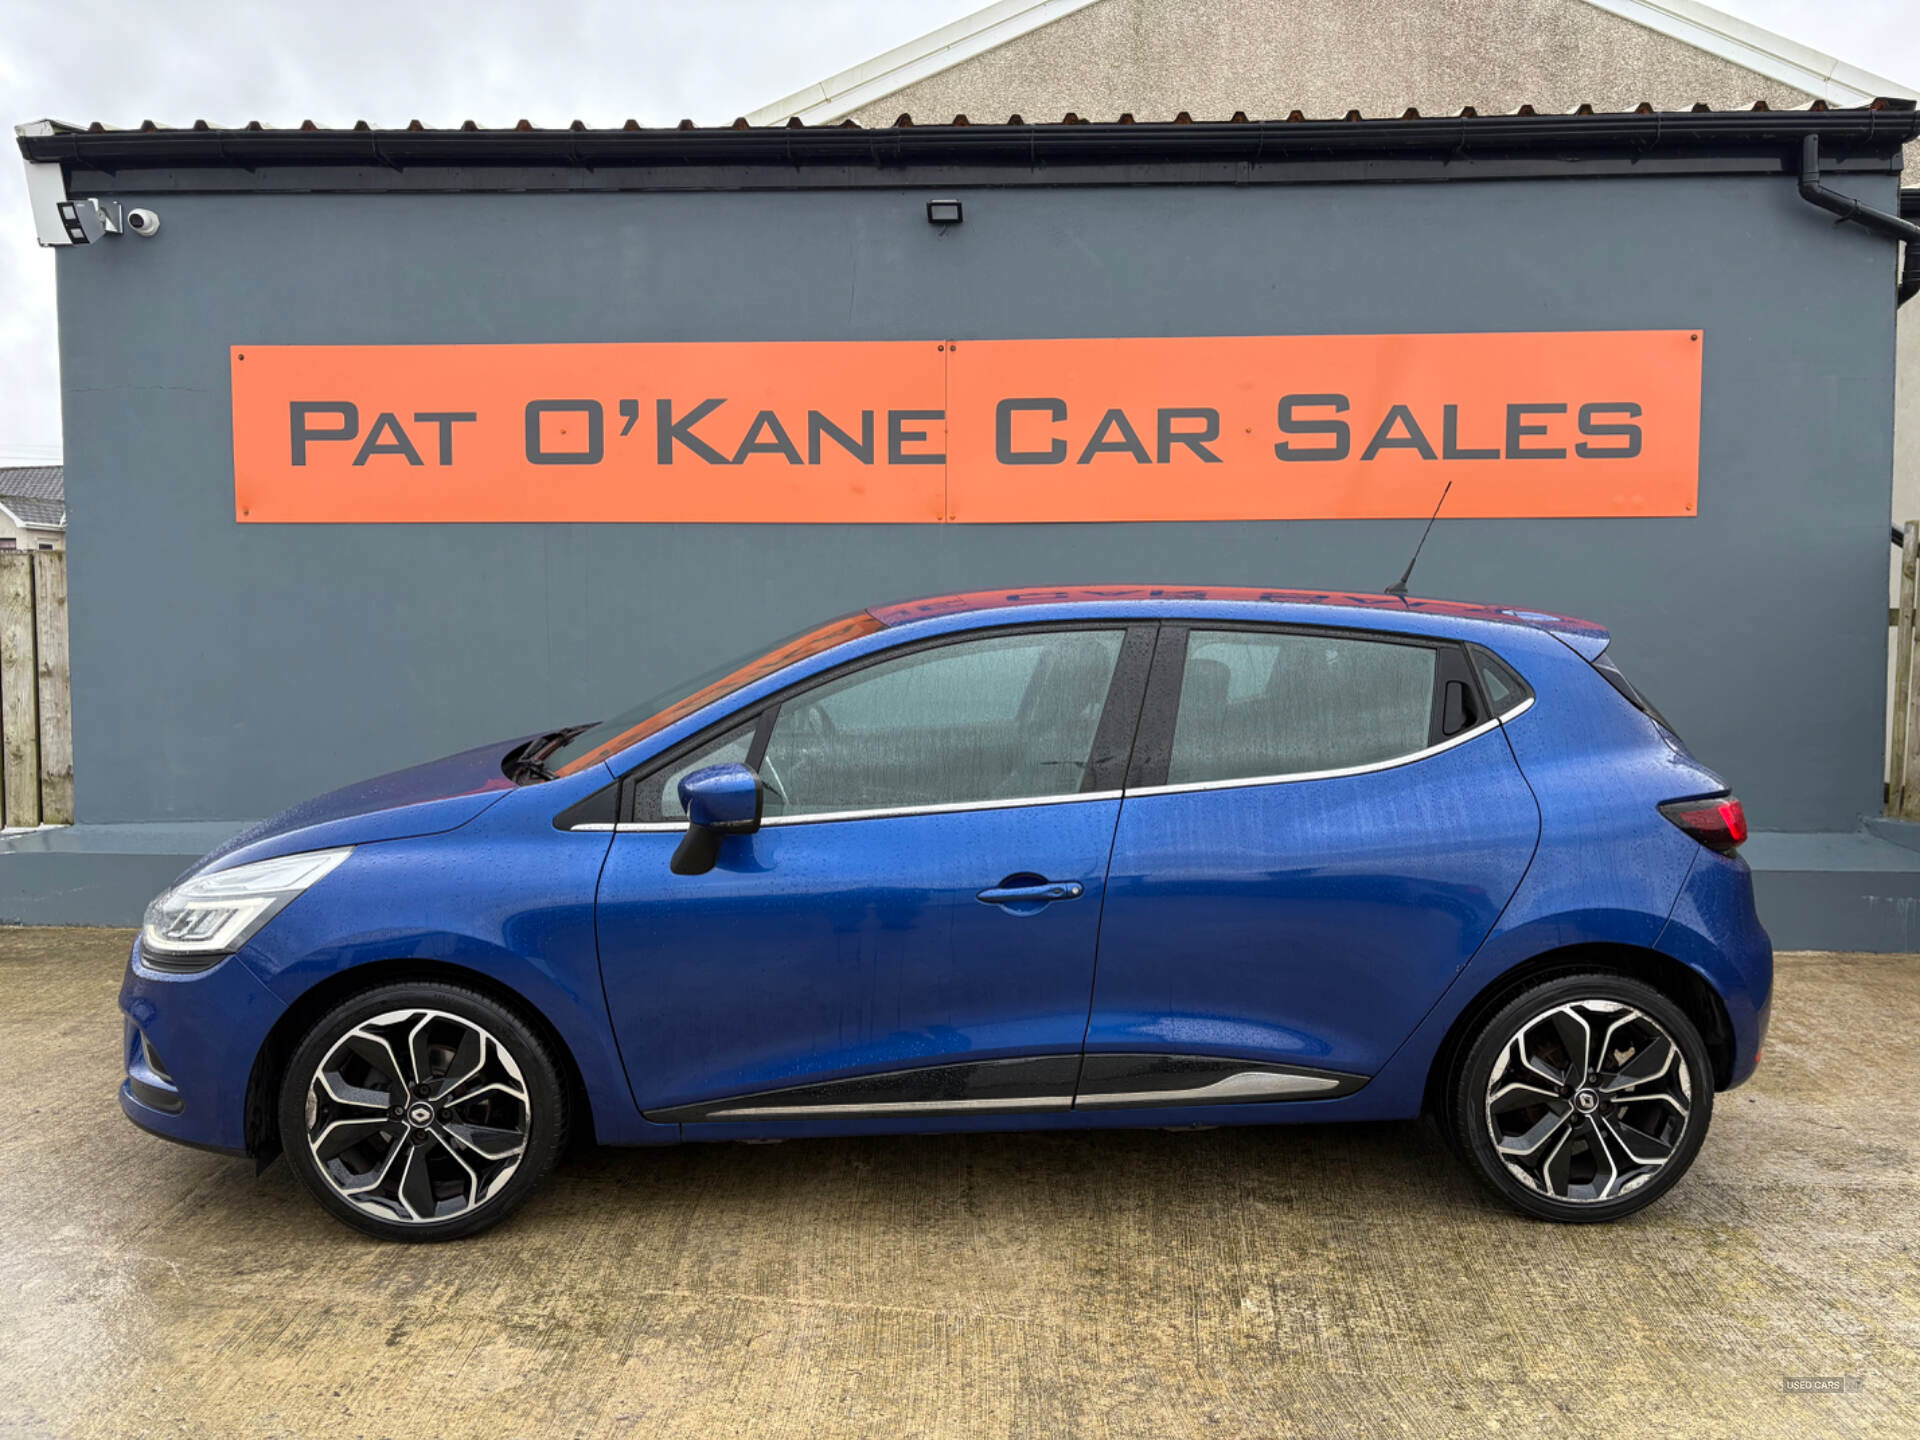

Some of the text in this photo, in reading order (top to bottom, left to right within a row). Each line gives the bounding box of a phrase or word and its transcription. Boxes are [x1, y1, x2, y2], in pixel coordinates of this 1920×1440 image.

[290, 393, 1642, 467] PAT O'KANE CAR SALES
